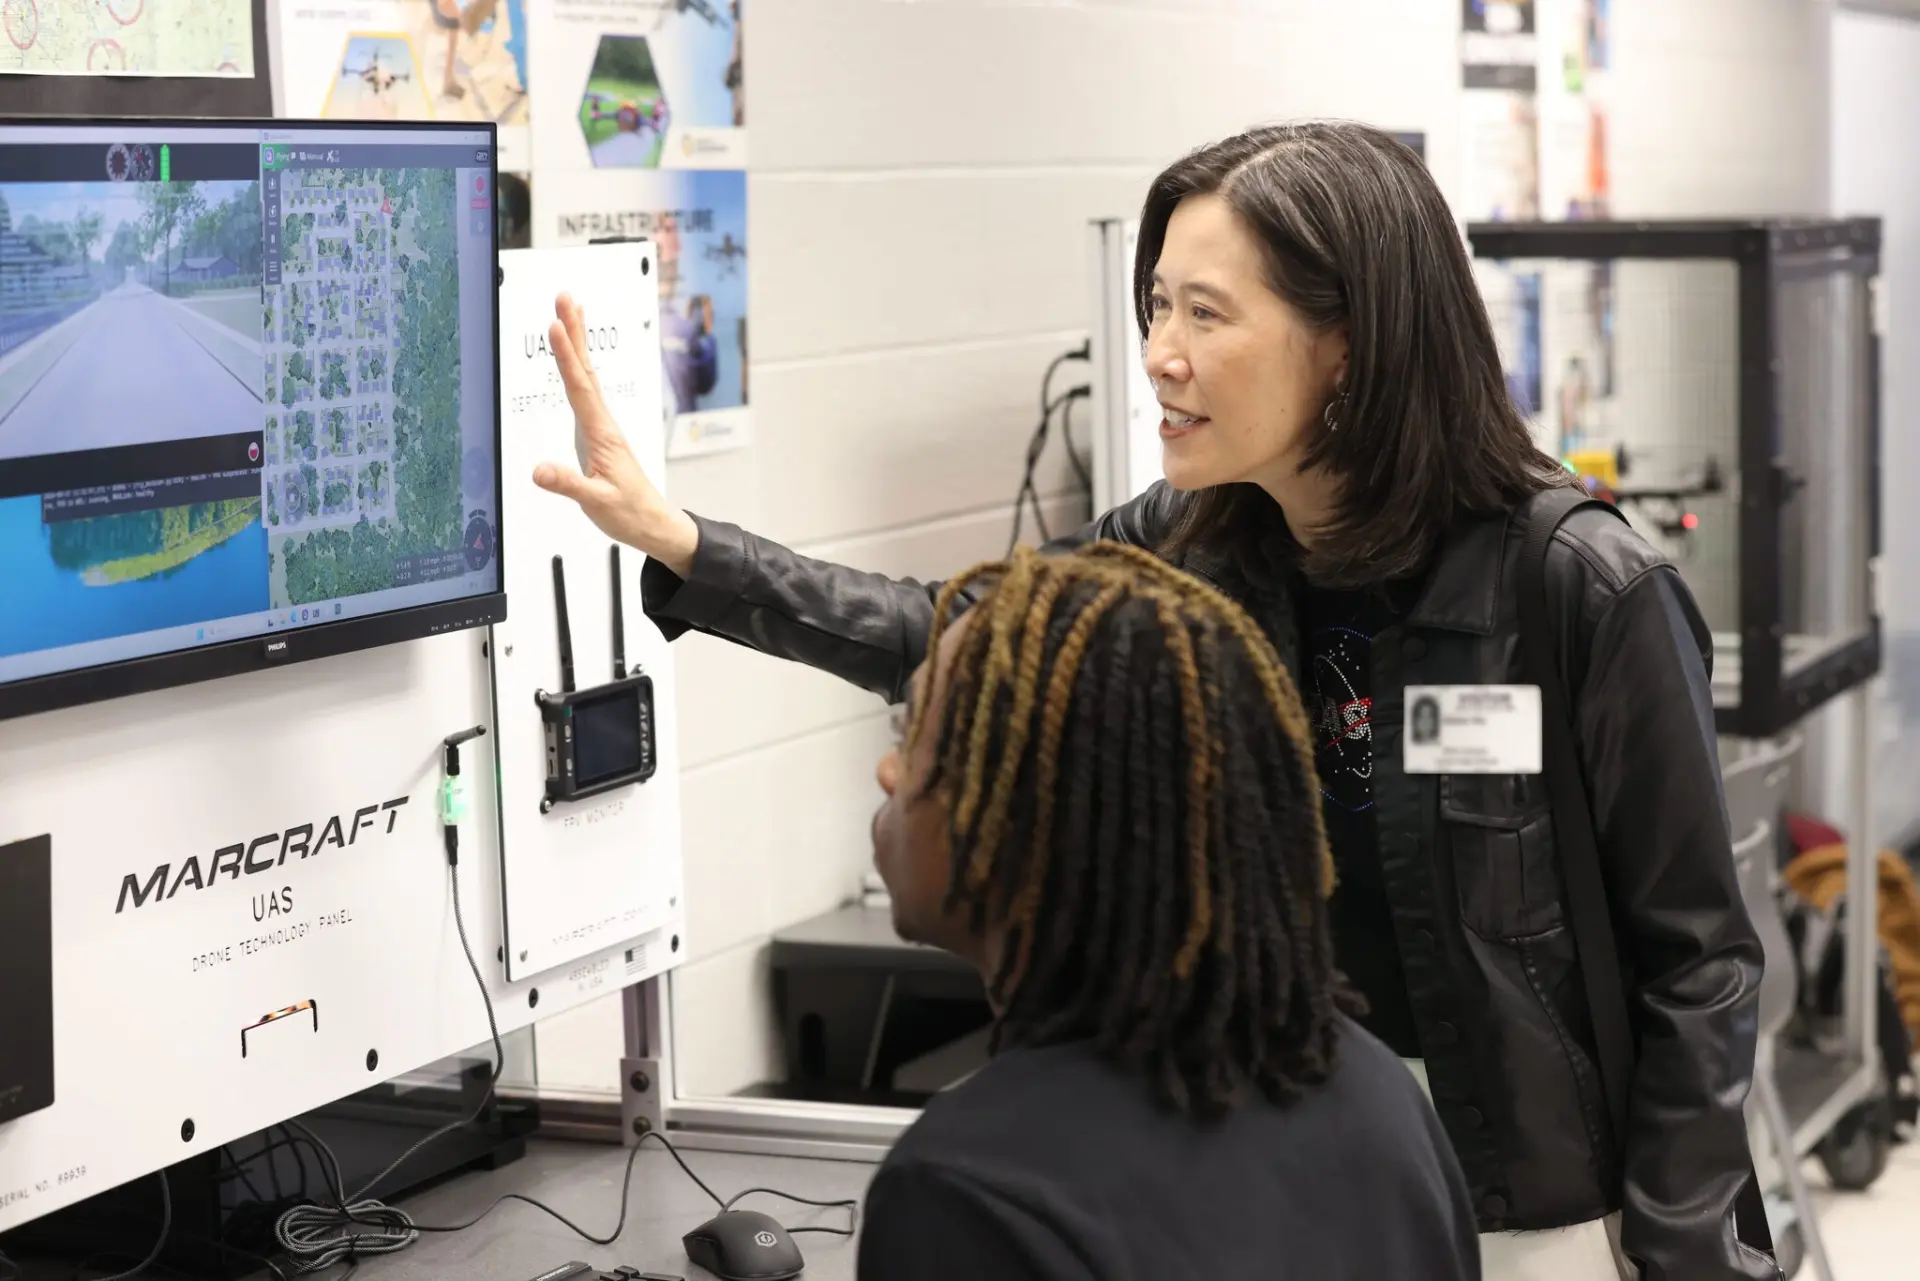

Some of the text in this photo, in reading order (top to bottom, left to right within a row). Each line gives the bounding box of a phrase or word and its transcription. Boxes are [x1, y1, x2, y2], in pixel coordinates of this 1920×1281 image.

[267, 641, 287, 652] PHILIPS
[115, 796, 410, 914] MARCRAFT
[252, 886, 293, 922] UAS
[192, 909, 353, 972] DRONE TECHNOLOGY PANEL
